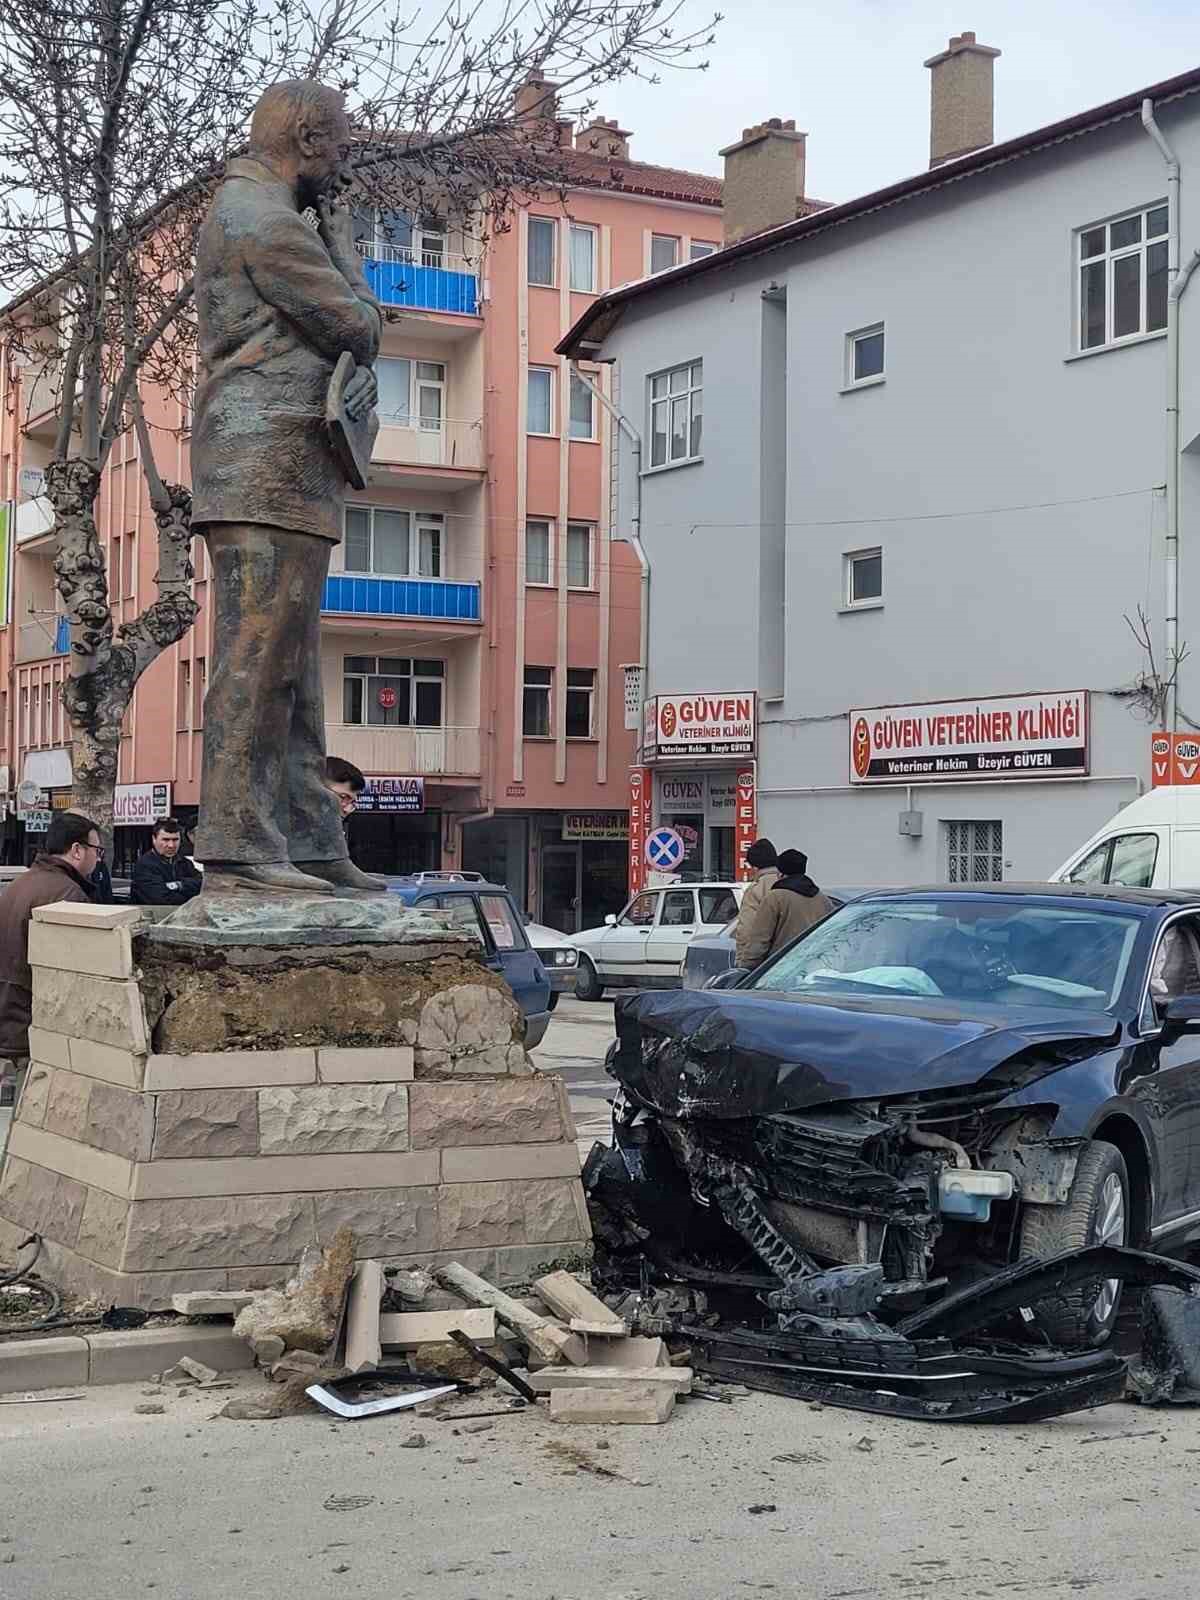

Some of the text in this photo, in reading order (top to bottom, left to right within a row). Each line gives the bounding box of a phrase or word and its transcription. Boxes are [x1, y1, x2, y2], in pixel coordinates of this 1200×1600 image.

[680, 696, 751, 722] GÜVEN
[679, 723, 752, 739] VETERİNER KLİNİĞİ
[873, 698, 1081, 749] GÜVEN VETERİNER KLİNİĞİ
[887, 751, 1053, 773] Veteriner Hekim Üzeyir GÜVEN
[369, 780, 420, 795] HELVA
[663, 778, 703, 798] GÜVEN
